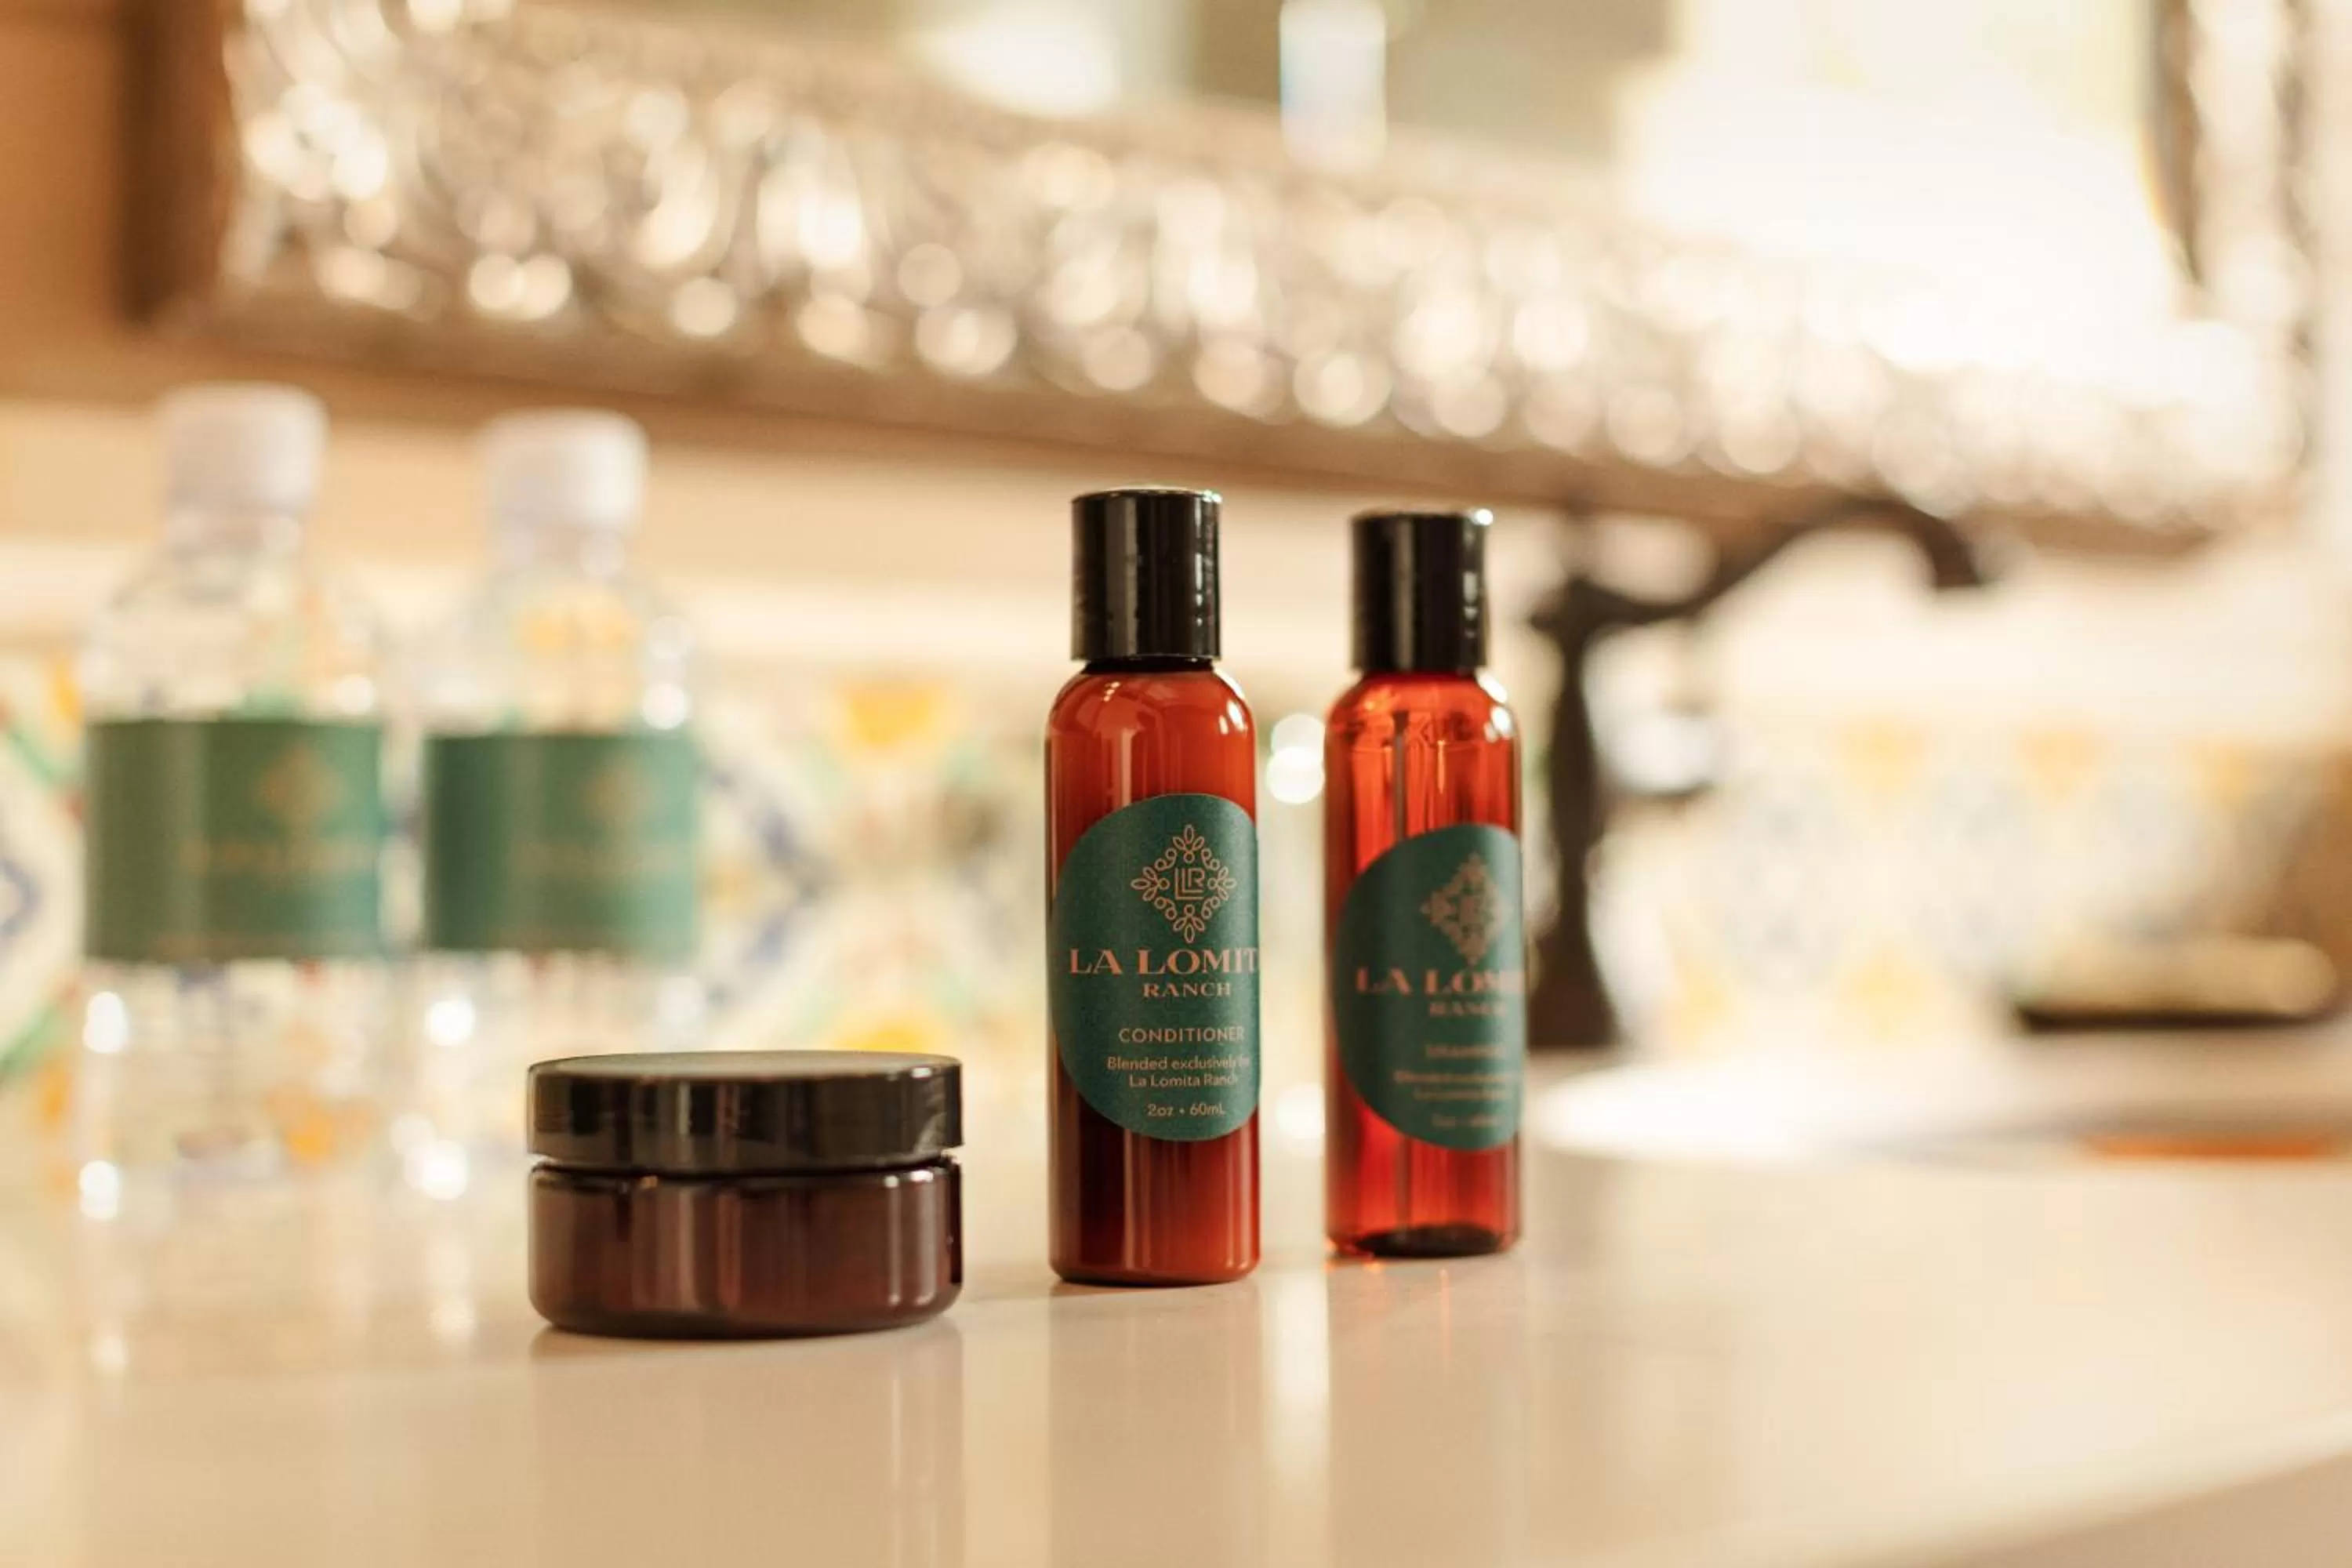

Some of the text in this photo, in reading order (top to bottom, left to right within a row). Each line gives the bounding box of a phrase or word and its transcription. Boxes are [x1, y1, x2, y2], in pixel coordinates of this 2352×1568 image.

[1069, 948, 1123, 975] LA
[1356, 967, 1412, 994] LA
[1143, 982, 1231, 998] RANCH
[1119, 1026, 1245, 1043] CONDITIONER
[1107, 1056, 1167, 1070] Blended
[1129, 1075, 1147, 1087] La
[1151, 1074, 1200, 1088] Lomita
[1147, 1103, 1174, 1117] 2oz
[1189, 1102, 1225, 1116] 60mL
